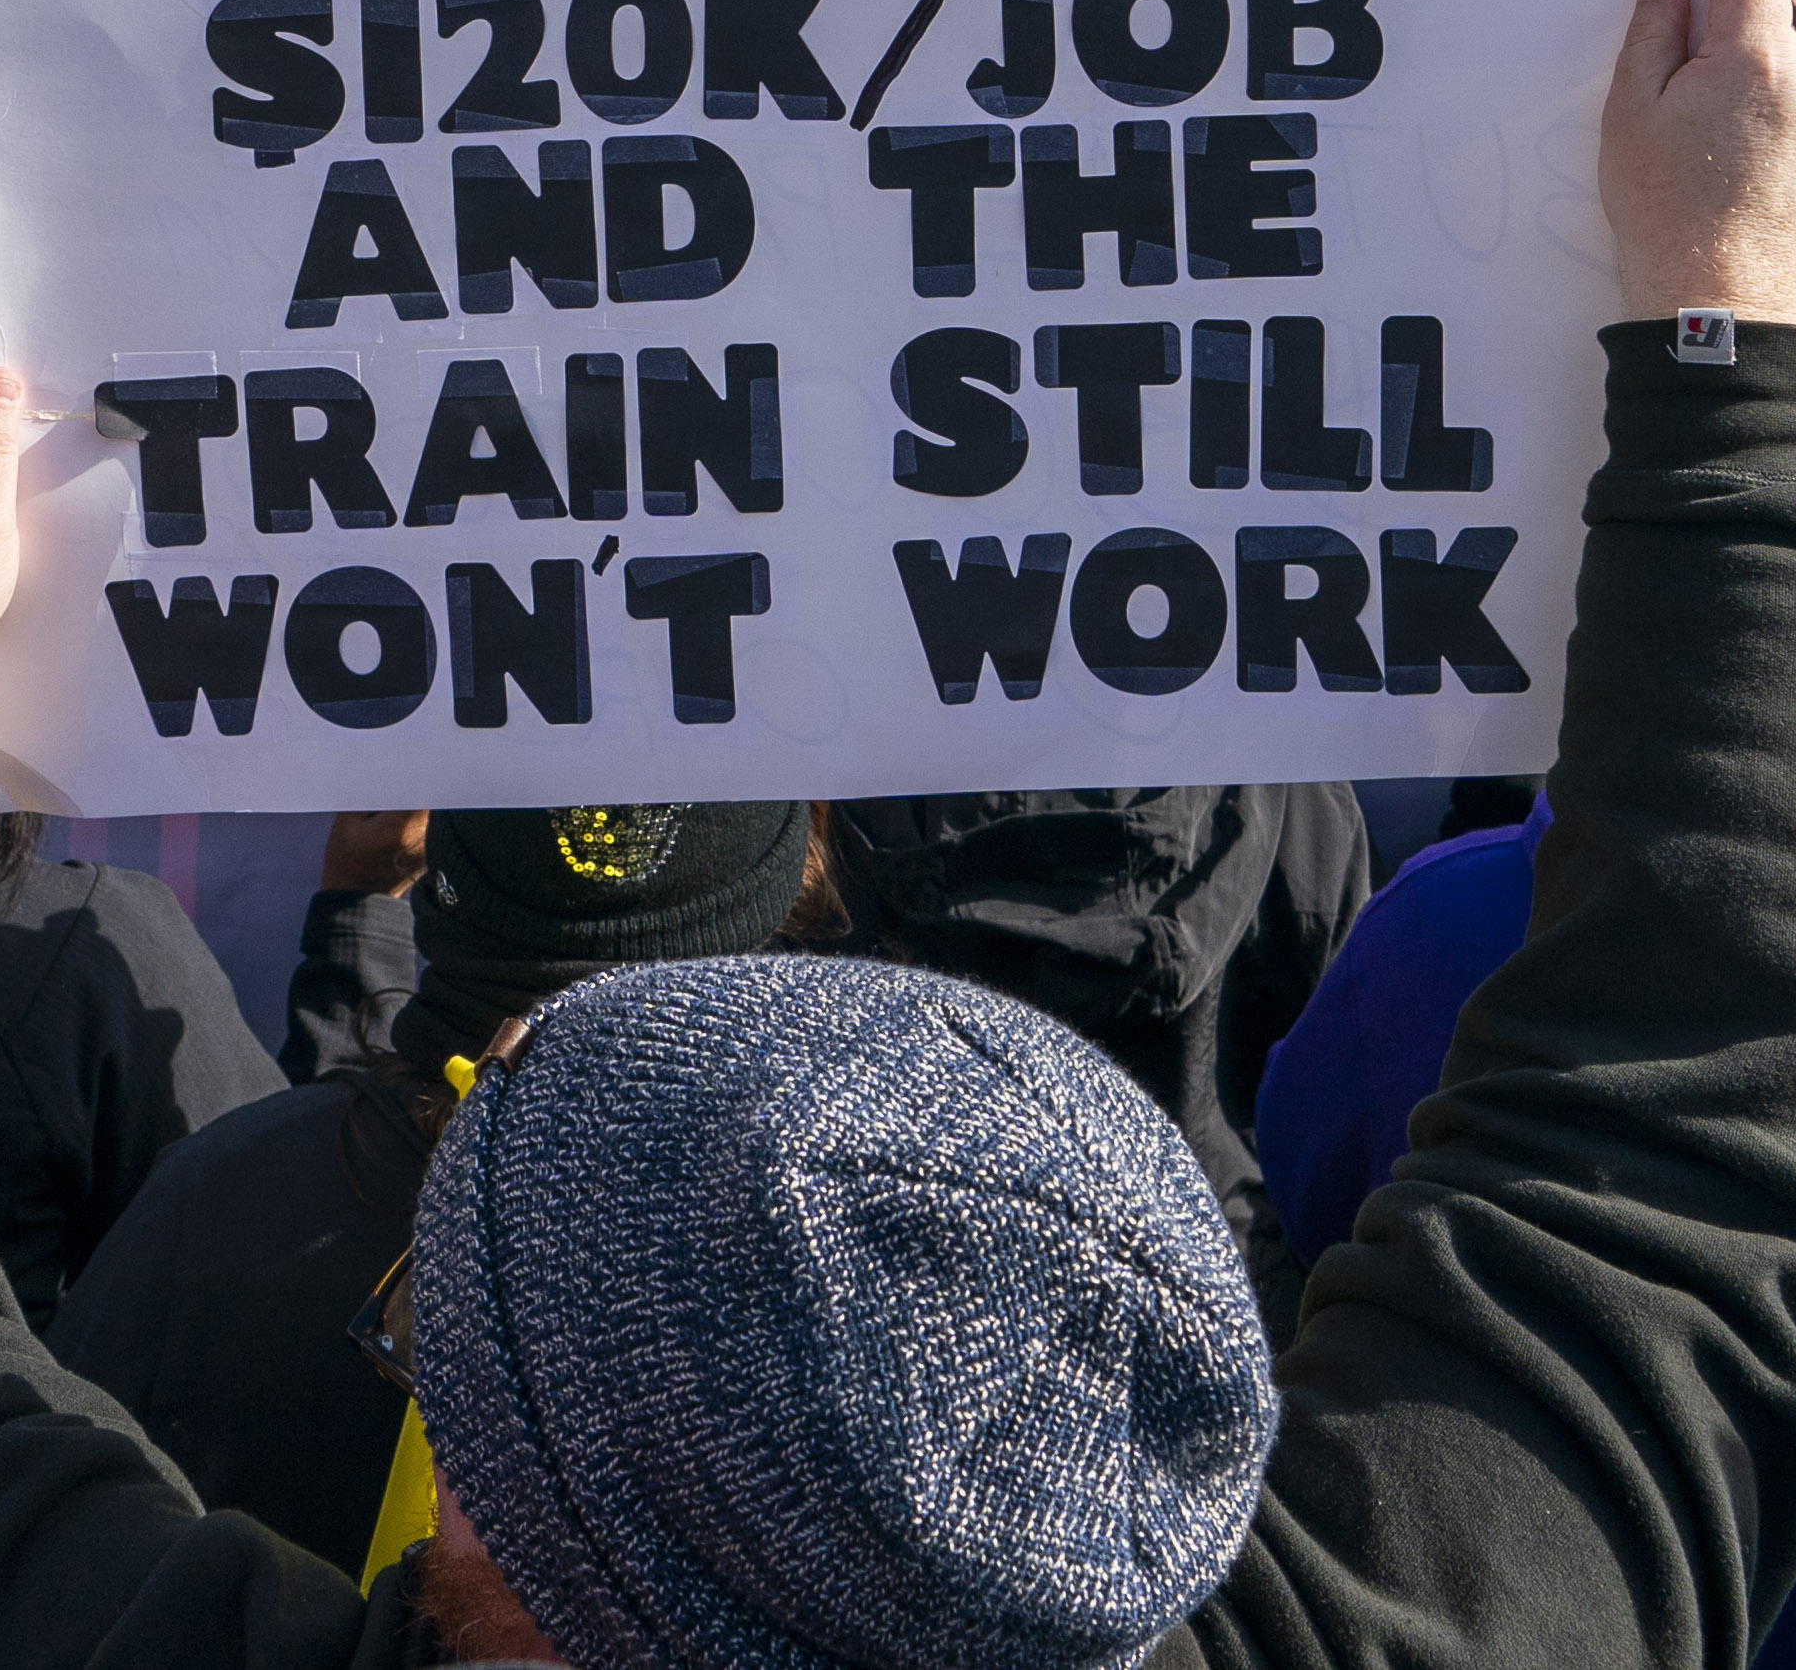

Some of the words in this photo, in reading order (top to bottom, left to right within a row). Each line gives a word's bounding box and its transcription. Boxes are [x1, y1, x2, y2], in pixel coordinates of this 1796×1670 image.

[283, 133, 757, 331] AND
[866, 110, 1325, 300] THE
[92, 341, 786, 550] TRAIN
[888, 314, 1496, 499] STILL
[103, 533, 773, 740] WON'T
[890, 524, 1534, 707] WORK
